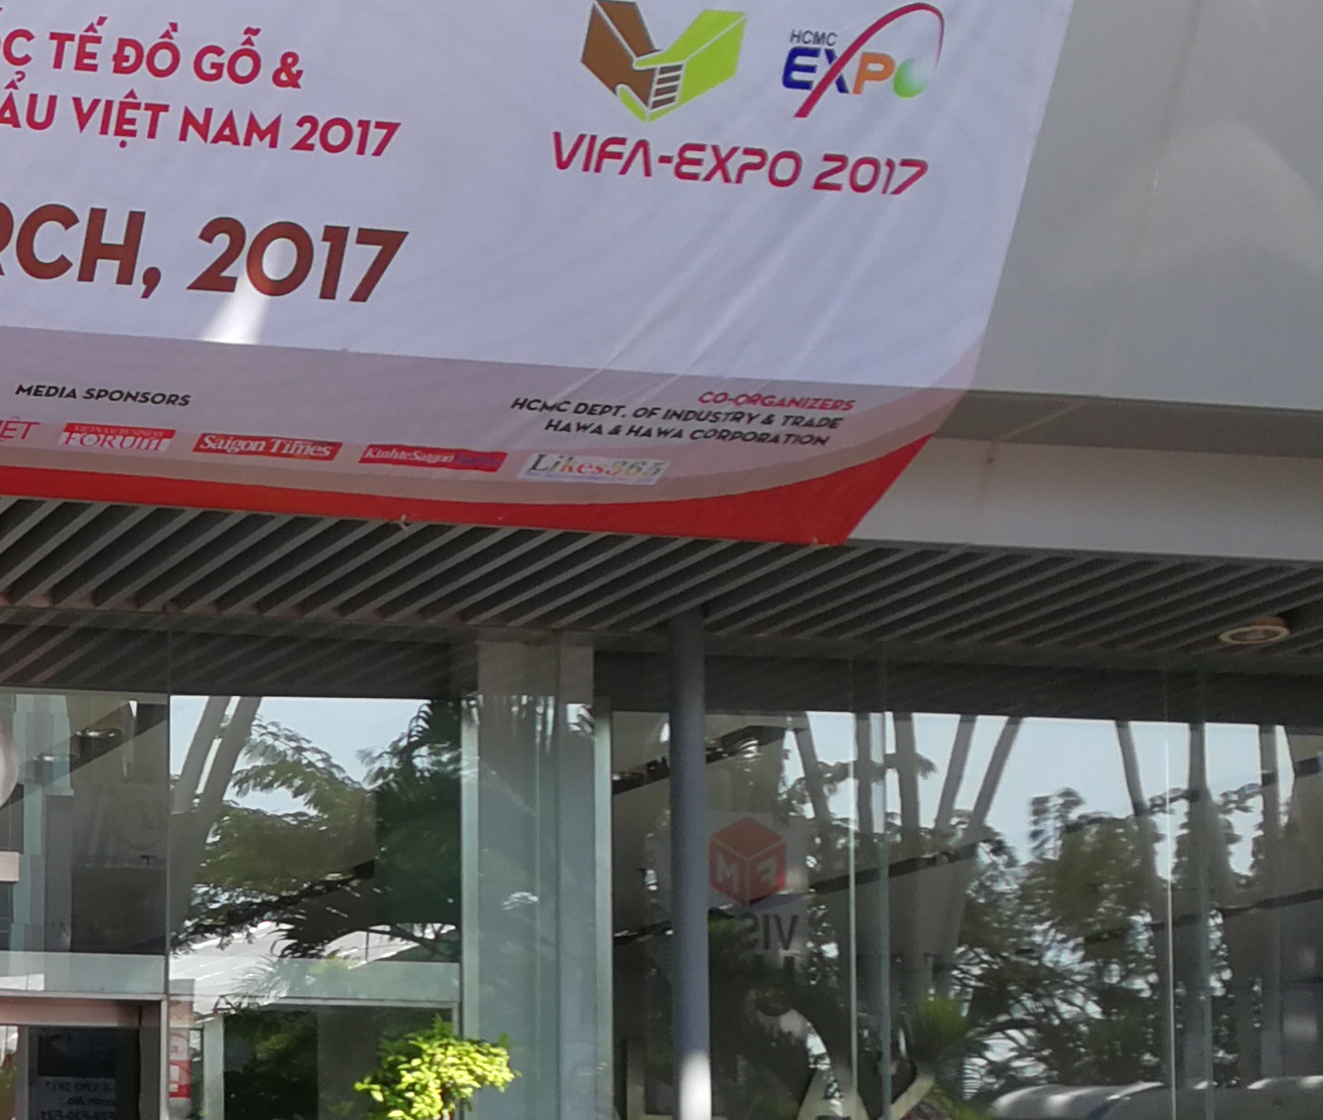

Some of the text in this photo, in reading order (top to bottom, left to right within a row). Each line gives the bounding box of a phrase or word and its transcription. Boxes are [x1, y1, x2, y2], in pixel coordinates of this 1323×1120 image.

[49, 16, 108, 72] TẾ
[112, 22, 181, 78] ĐỒ
[193, 27, 262, 85] GỖ
[272, 51, 304, 89] &
[789, 29, 837, 47] HCMC
[71, 89, 169, 149] VIỆT
[178, 105, 282, 149] NAM
[290, 114, 402, 157] 2017
[553, 131, 928, 195] VIFA-EXPO 2017
[187, 215, 410, 304] 2017
[15, 384, 191, 407] MEDIA SPONSORS
[698, 391, 857, 412] CO-ORGANIZERS
[511, 398, 844, 430] HCMC DEPT. OF INDUSTRY & TRADE
[200, 434, 332, 457] Saigon Times
[544, 418, 831, 447] HAWA & HAWA CORPORATION
